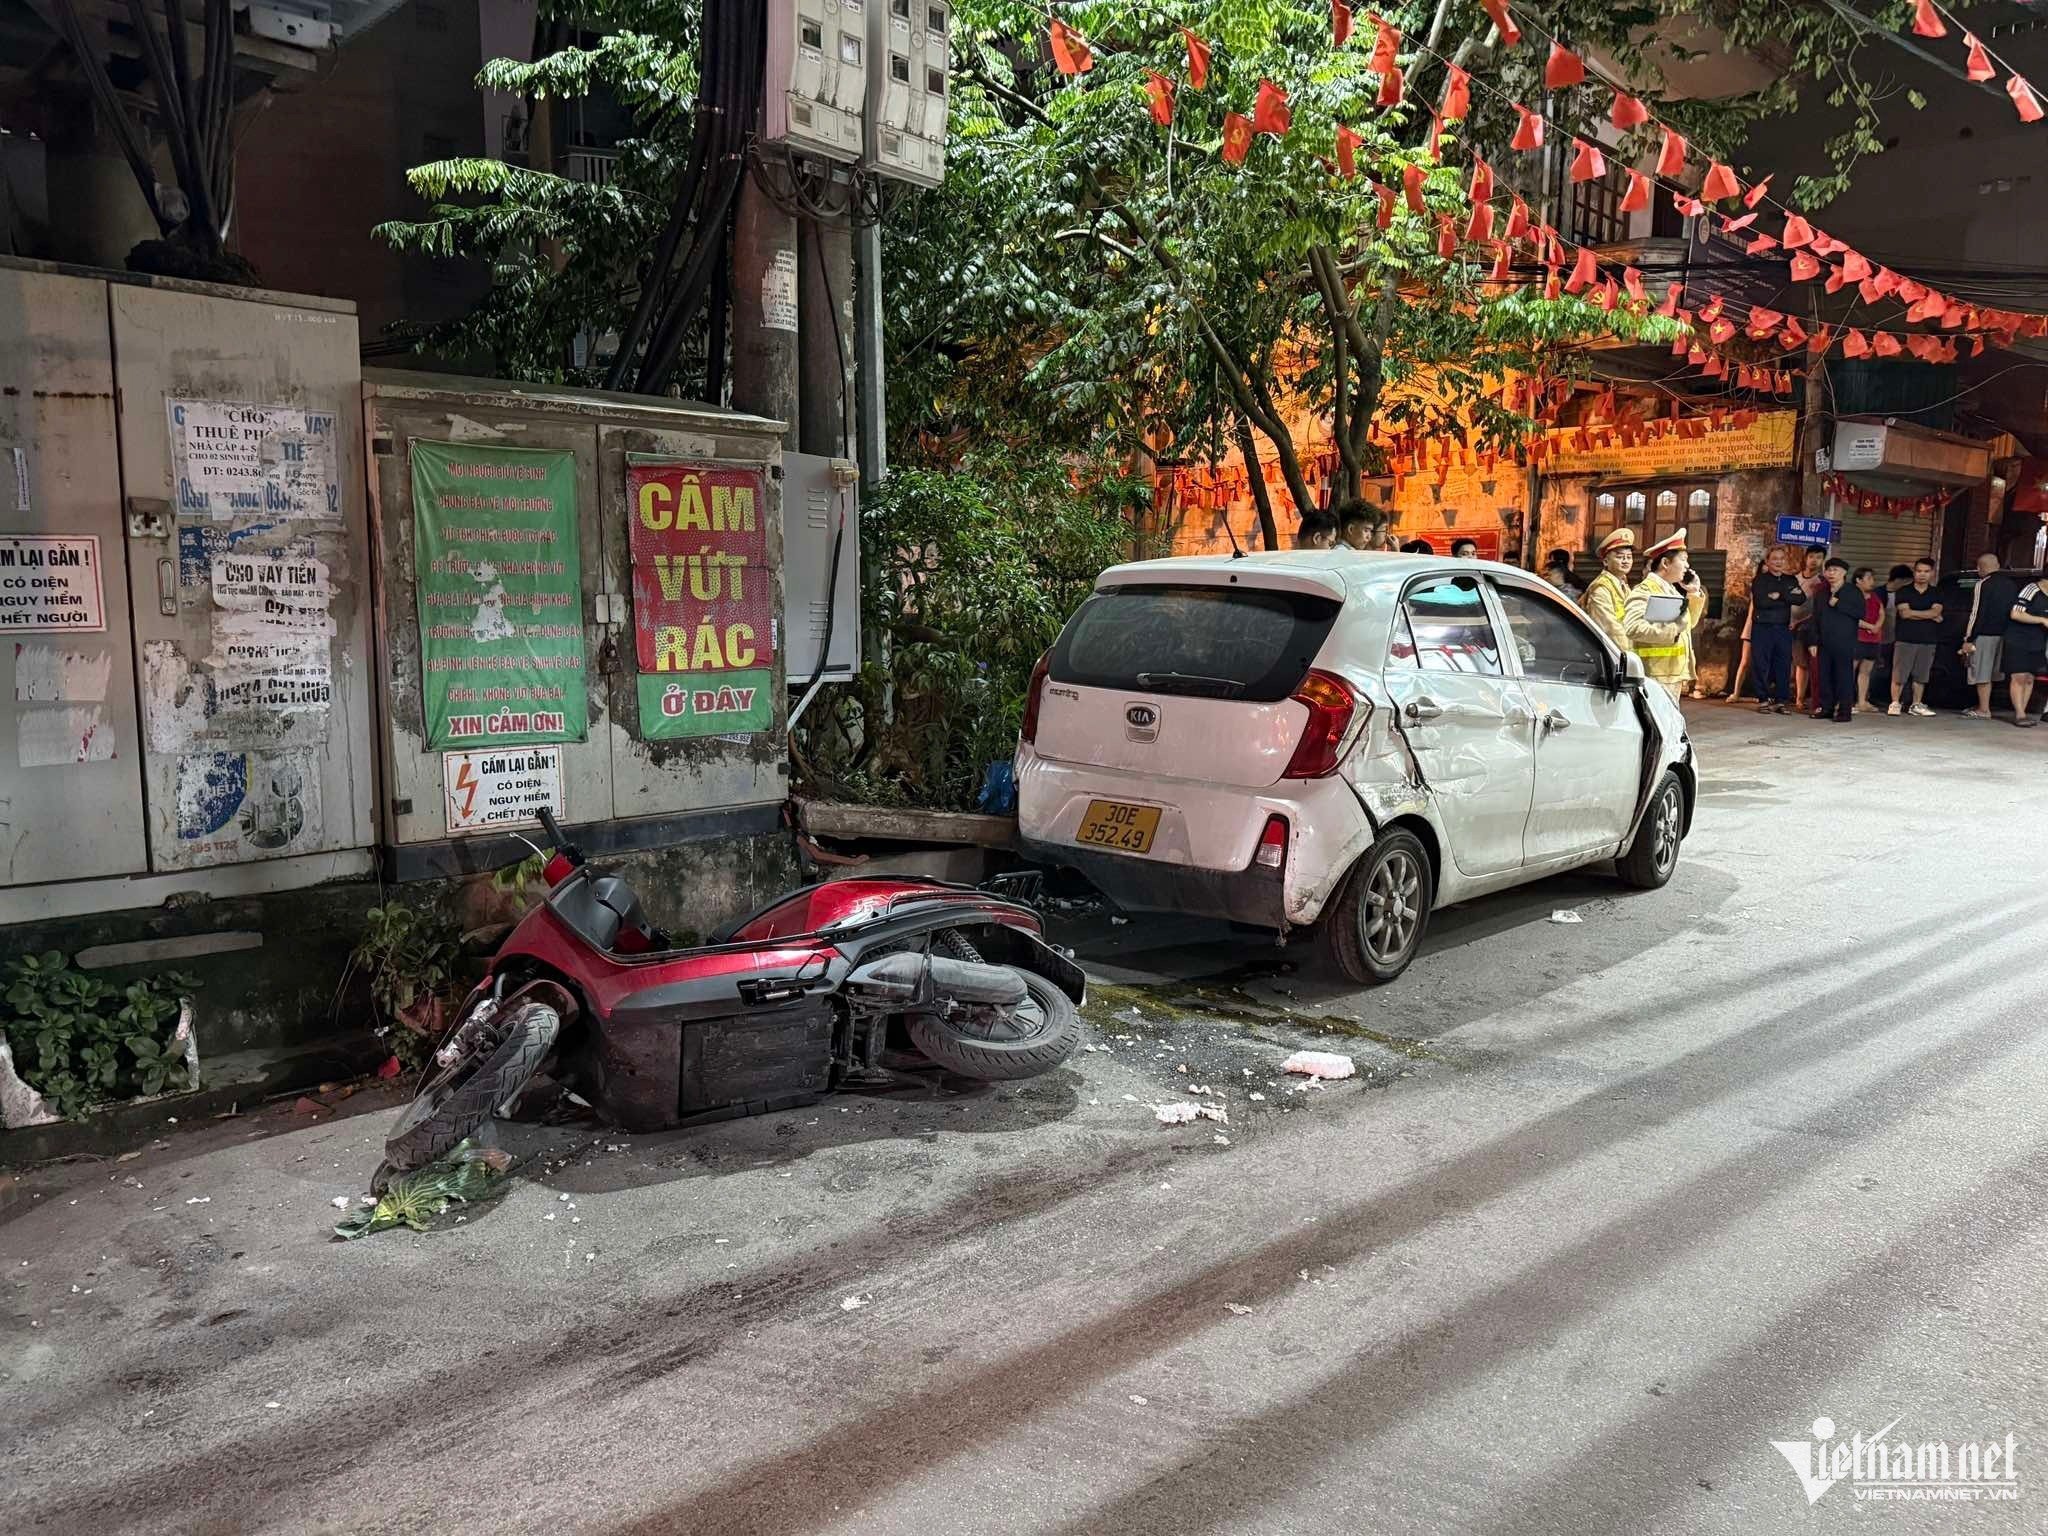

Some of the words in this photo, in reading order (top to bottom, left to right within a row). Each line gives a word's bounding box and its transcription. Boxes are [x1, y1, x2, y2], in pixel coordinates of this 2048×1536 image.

[193, 425, 239, 440] THUÊ
[304, 415, 332, 435] VAY
[638, 471, 755, 532] CẤM
[1808, 521, 1821, 533] 197
[20, 549, 44, 570] LẠI
[48, 543, 80, 567] GẦN
[3, 575, 26, 588] CÓ
[31, 575, 69, 591] ĐIỆN
[654, 546, 748, 602] VỨT
[44, 591, 82, 606] HIỂM
[0, 610, 32, 623] HẾT
[37, 610, 88, 623] NGƯỜI
[655, 615, 756, 672] RÁC
[661, 683, 687, 717] Ở
[693, 685, 756, 714] ĐÂY
[449, 715, 483, 736] XIN
[487, 707, 529, 734] CẢM
[533, 712, 565, 733] ƠN!
[1130, 709, 1150, 723] KIA
[481, 754, 506, 775] CẤM
[508, 757, 525, 775] LẠI
[497, 779, 513, 791] CÓ
[489, 795, 521, 806] NGUY
[524, 789, 551, 803] HIỂM
[487, 806, 516, 821] CHẾT
[1104, 805, 1139, 827] 30E
[1085, 823, 1145, 850] 352.49
